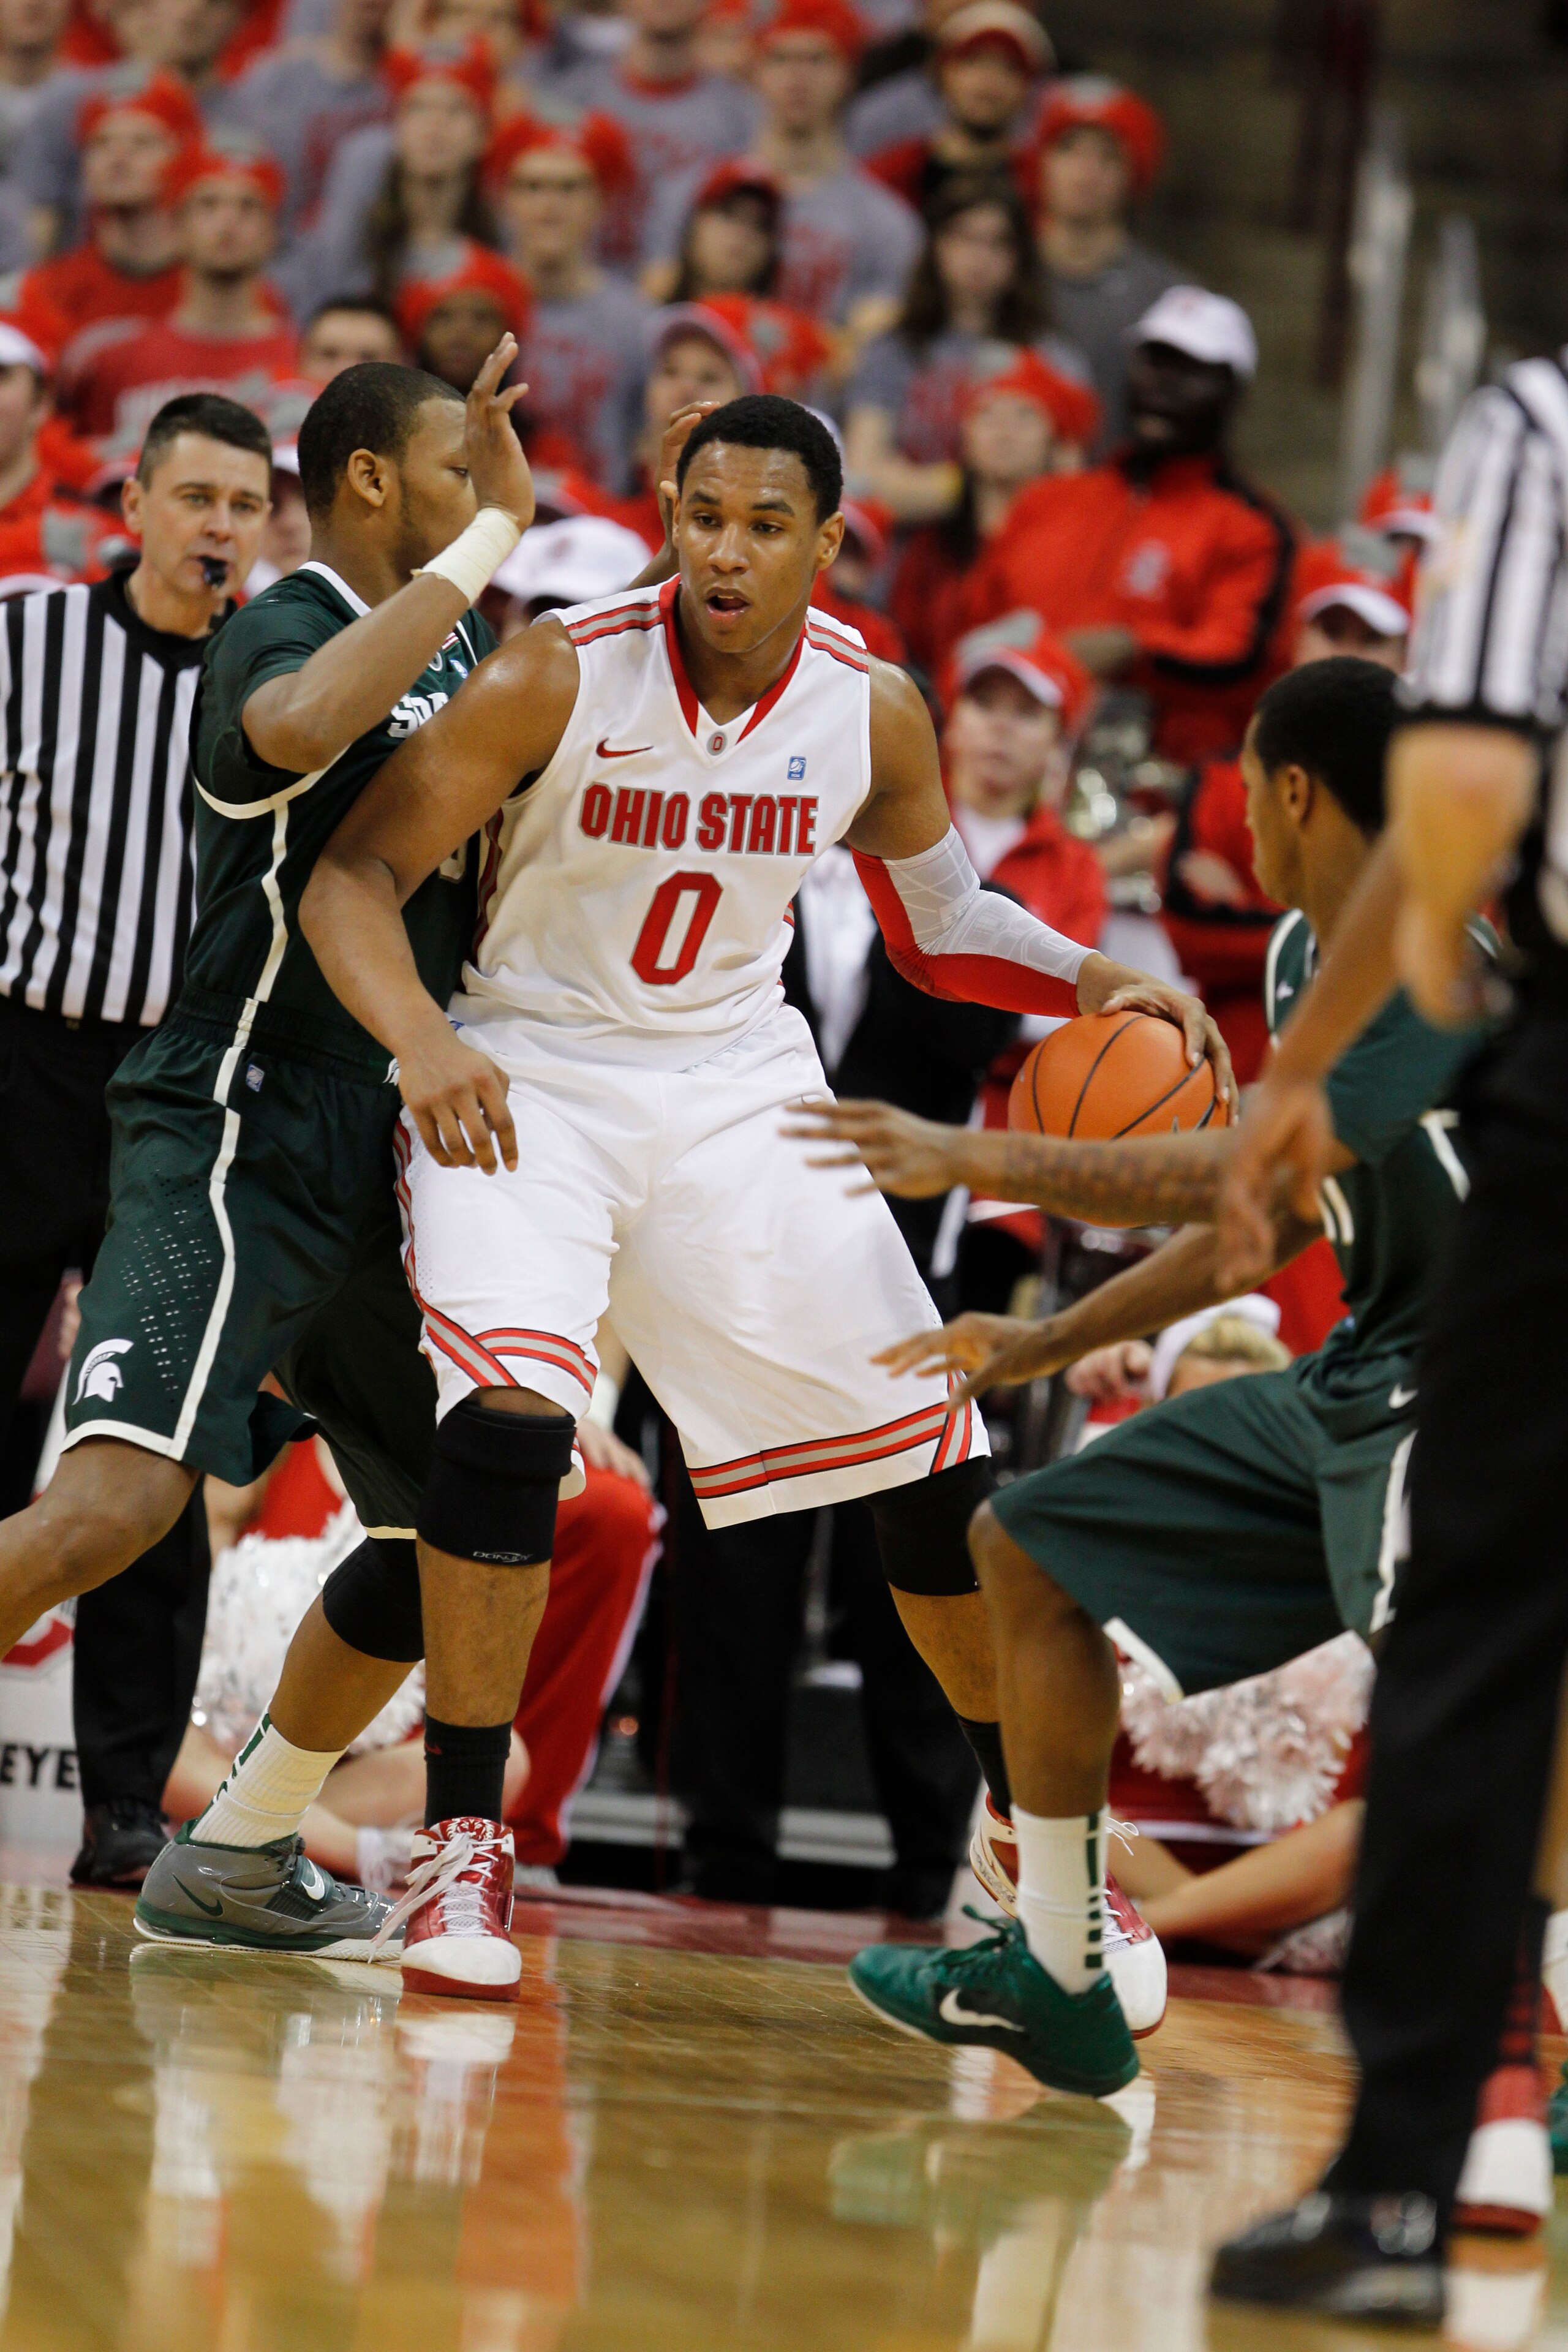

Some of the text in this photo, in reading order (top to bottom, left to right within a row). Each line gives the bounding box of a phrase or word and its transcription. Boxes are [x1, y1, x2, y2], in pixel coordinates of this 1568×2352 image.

[578, 782, 820, 856] OHIO STATE
[629, 870, 724, 986] 0
